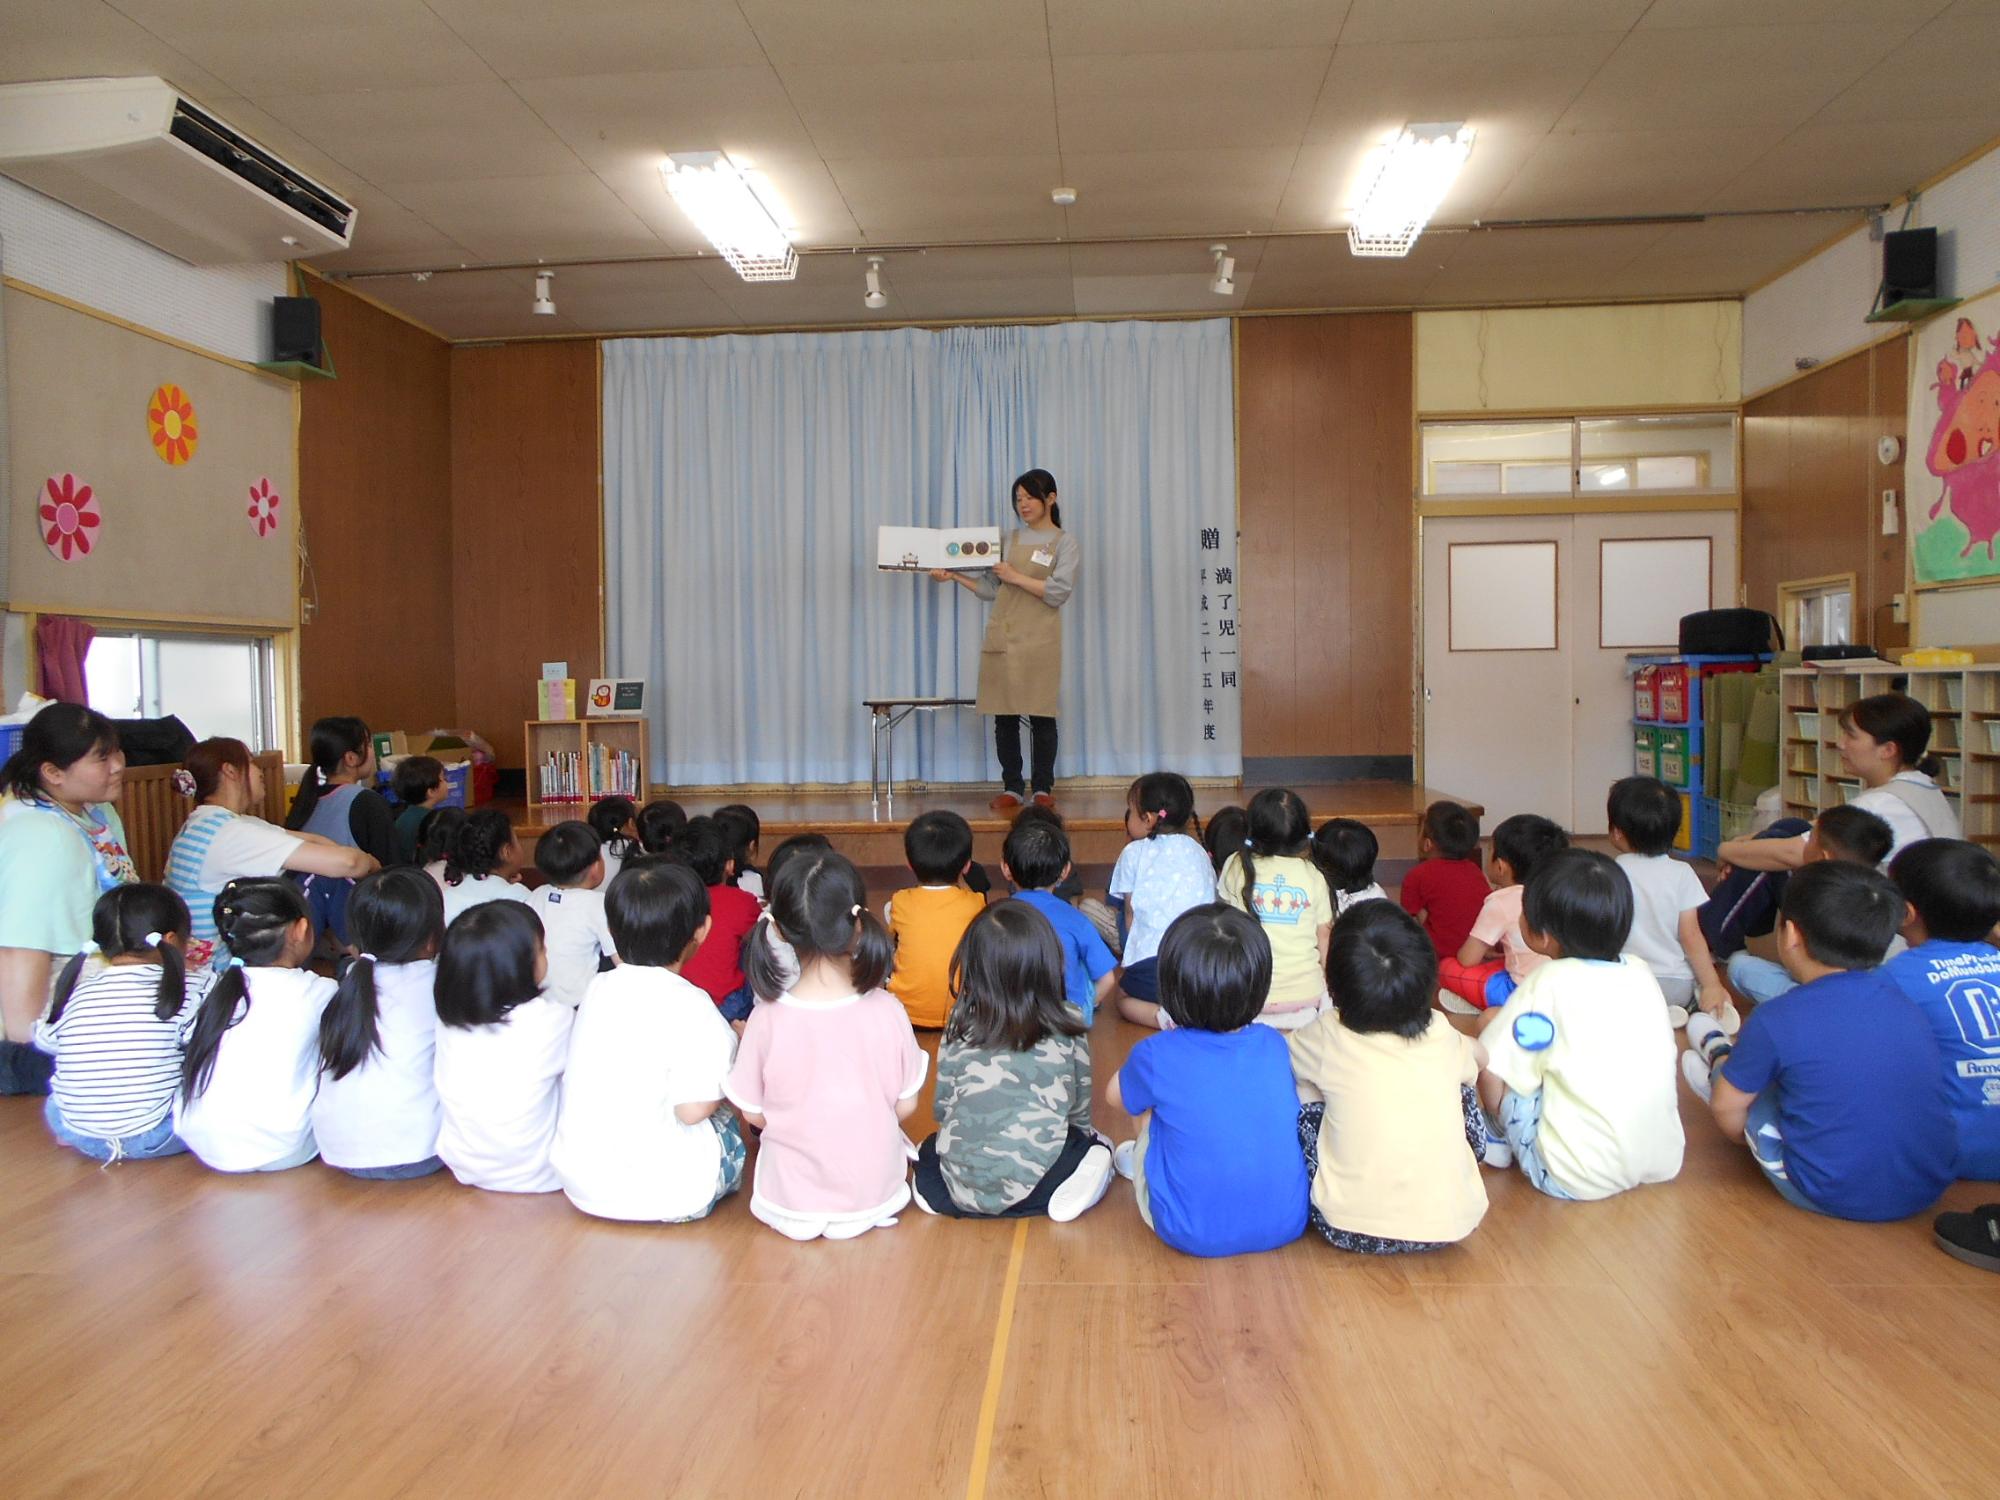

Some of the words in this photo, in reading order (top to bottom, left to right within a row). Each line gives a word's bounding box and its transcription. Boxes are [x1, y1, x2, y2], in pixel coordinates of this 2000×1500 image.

[1201, 527, 1220, 550] 贈
[1215, 567, 1236, 688] 満了児一同
